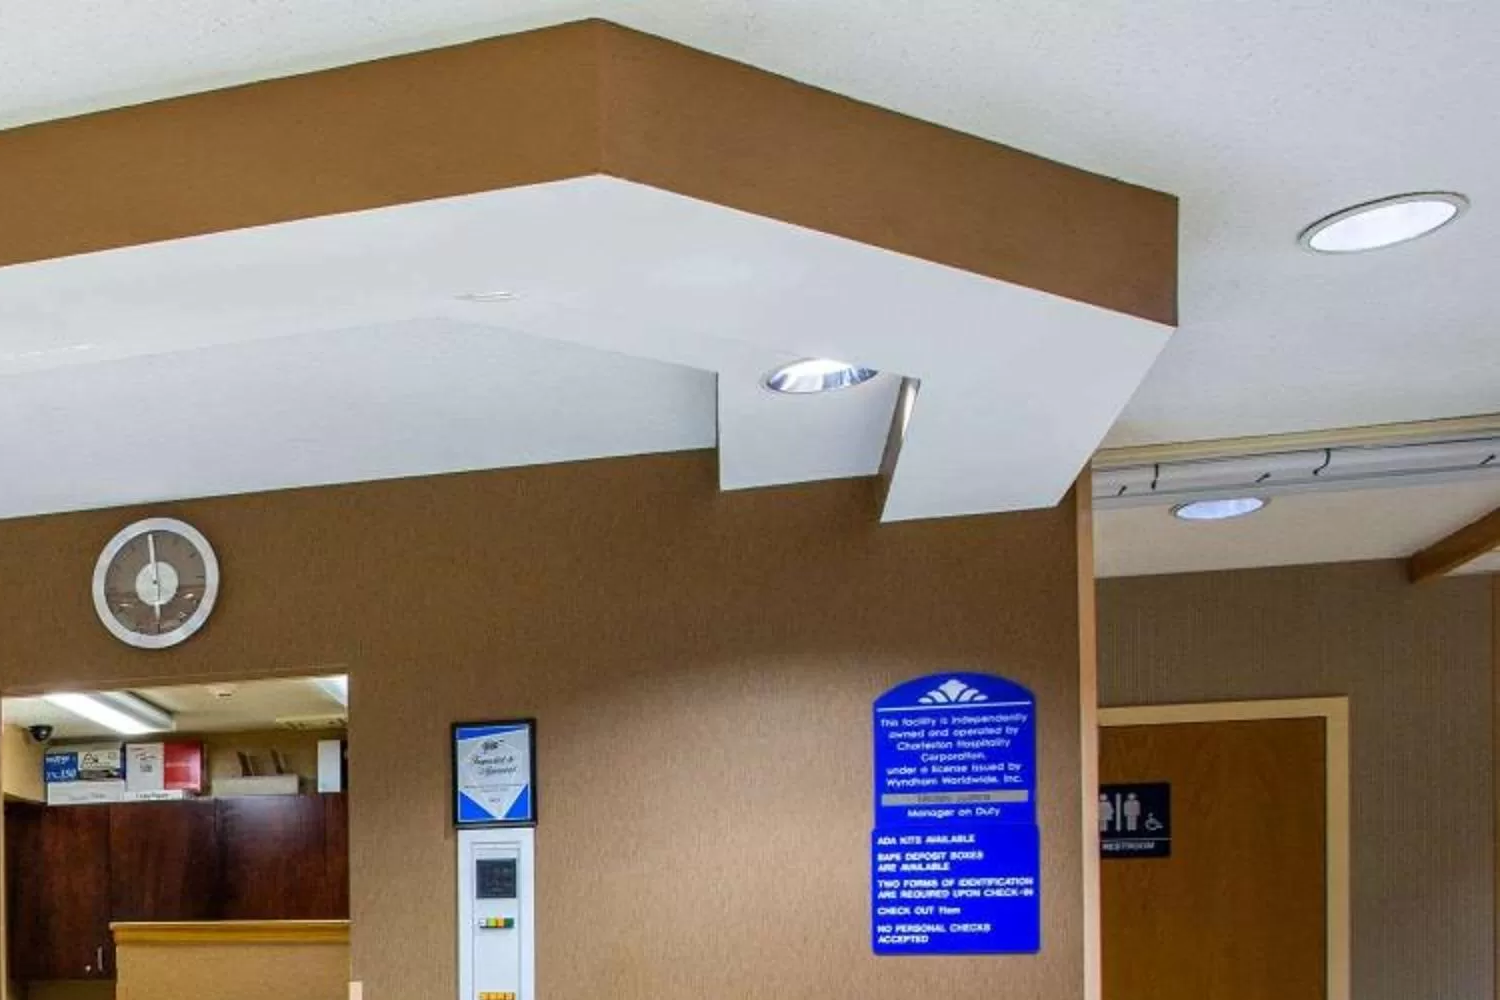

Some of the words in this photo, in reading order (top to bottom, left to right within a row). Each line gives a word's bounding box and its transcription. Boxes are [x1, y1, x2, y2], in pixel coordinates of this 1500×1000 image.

[902, 717, 936, 727] facility
[940, 717, 948, 725] is
[951, 713, 1028, 725] independently
[888, 729, 925, 739] owned
[928, 728, 949, 737] and
[952, 727, 1002, 738] operated
[1005, 726, 1020, 736] by
[896, 740, 953, 751] Charleston
[956, 738, 1011, 749] Hospitality
[886, 766, 917, 775] under
[931, 764, 968, 773] license
[971, 762, 1004, 771] issued
[1007, 762, 1022, 772] by
[886, 777, 938, 789] Wyndham
[907, 808, 955, 818] Manager
[958, 808, 972, 817] on
[975, 807, 1001, 818] Duty
[877, 836, 896, 845] ADA
[925, 834, 975, 843] AVAILABLE
[905, 851, 947, 861] DEPOSIT
[950, 850, 984, 860] BOXES
[877, 863, 897, 872] ARE
[900, 862, 950, 871] AVAILABLE
[877, 879, 900, 888] TWO
[903, 878, 938, 887] FORMS
[941, 878, 955, 887] OF
[958, 877, 1034, 886] IDENTIFICATION
[877, 890, 897, 899] ARE
[900, 889, 950, 899] REQUIRED
[952, 889, 981, 898] UPON
[983, 887, 1034, 897] CHECK-IN
[877, 906, 911, 915] CHECK
[914, 906, 935, 915] OUT
[877, 924, 893, 933] NO
[895, 923, 947, 933] PERSONAL
[950, 923, 991, 932] CHECKS
[877, 935, 929, 944] ACCEPTED
